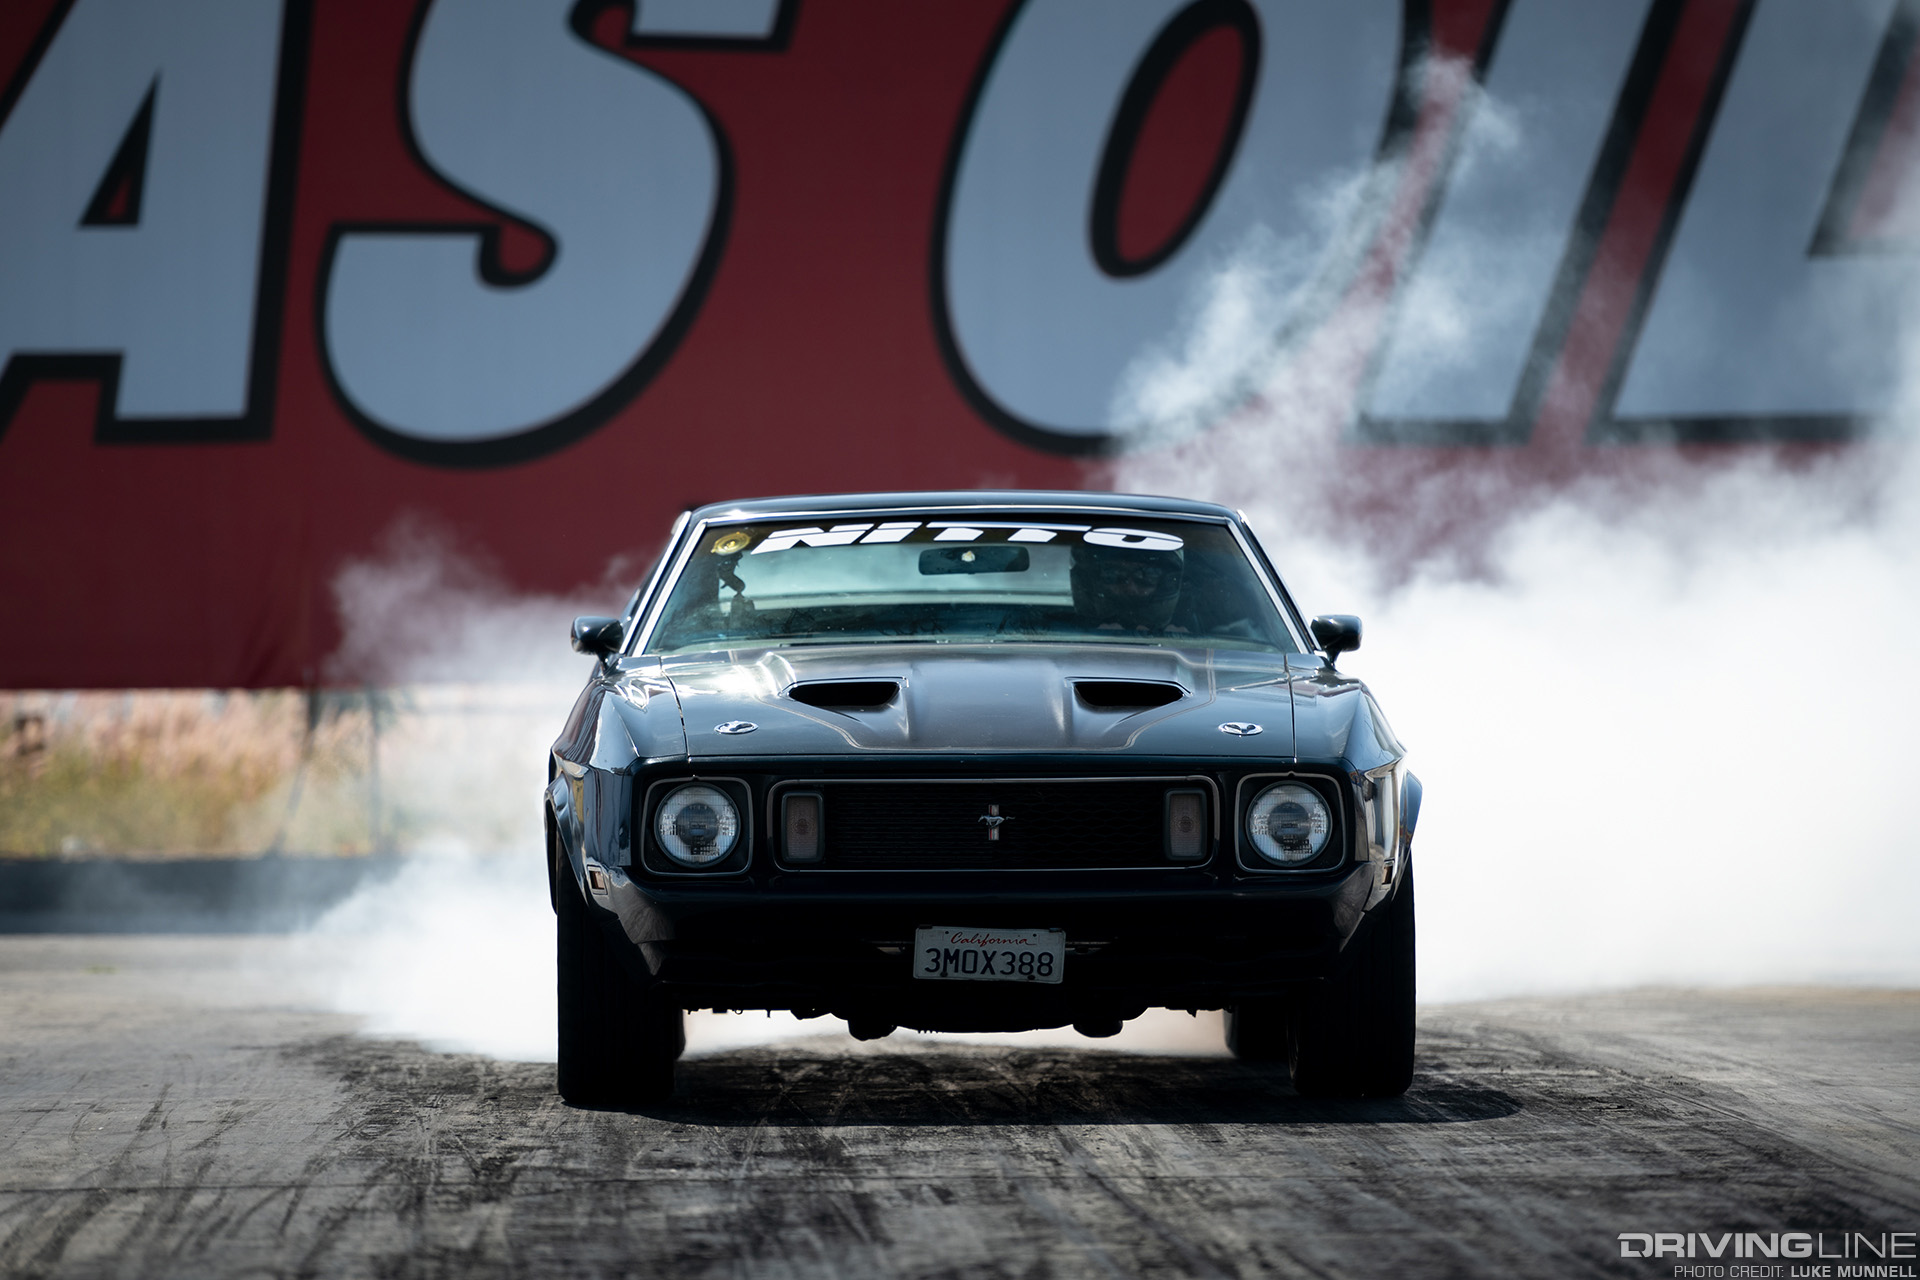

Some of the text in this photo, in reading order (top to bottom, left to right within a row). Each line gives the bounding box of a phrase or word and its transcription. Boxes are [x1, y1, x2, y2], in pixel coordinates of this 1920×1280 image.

[750, 521, 1184, 555] NITTO
[950, 931, 1037, 947] California
[924, 947, 1054, 977] 3MOX388
